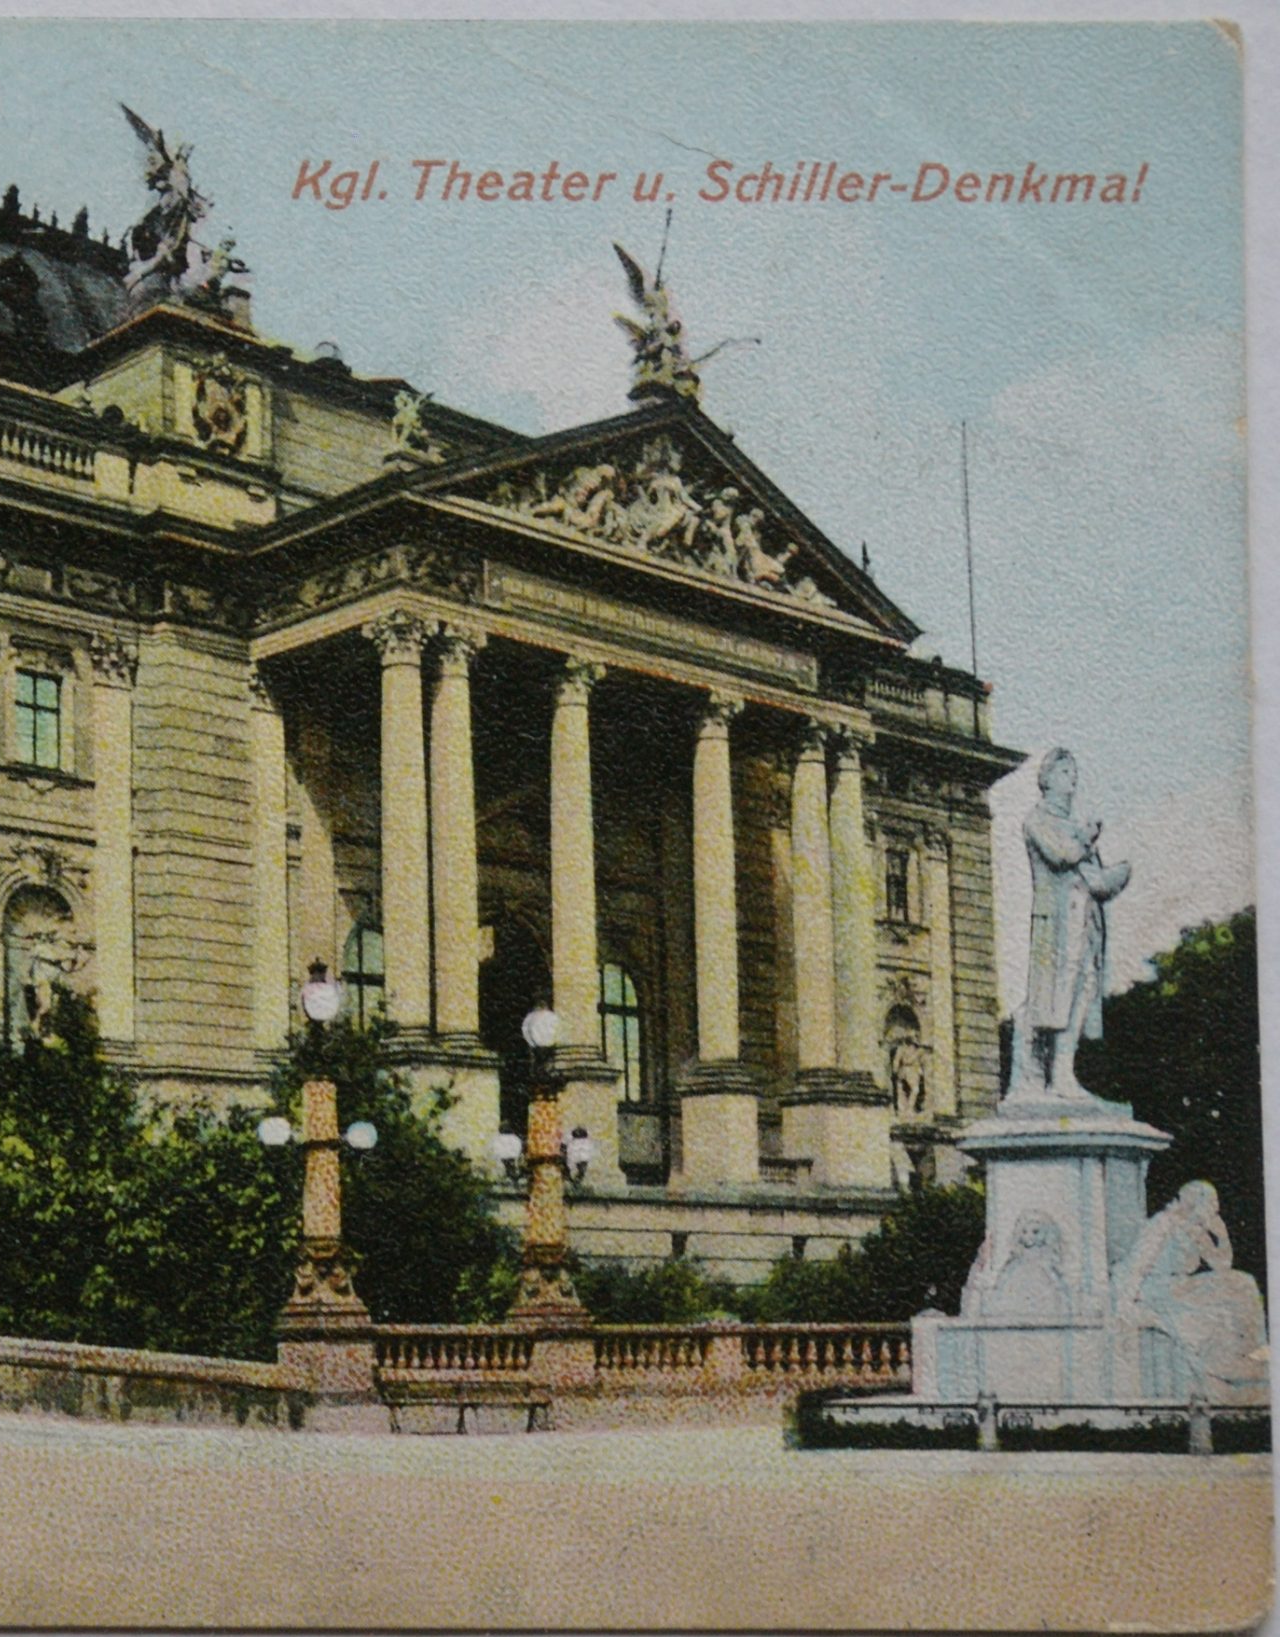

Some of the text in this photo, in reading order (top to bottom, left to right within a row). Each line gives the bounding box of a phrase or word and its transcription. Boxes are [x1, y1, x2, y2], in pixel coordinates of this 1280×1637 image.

[291, 158, 1149, 212] Kgl. Theater u. Schiller-Denkmal
